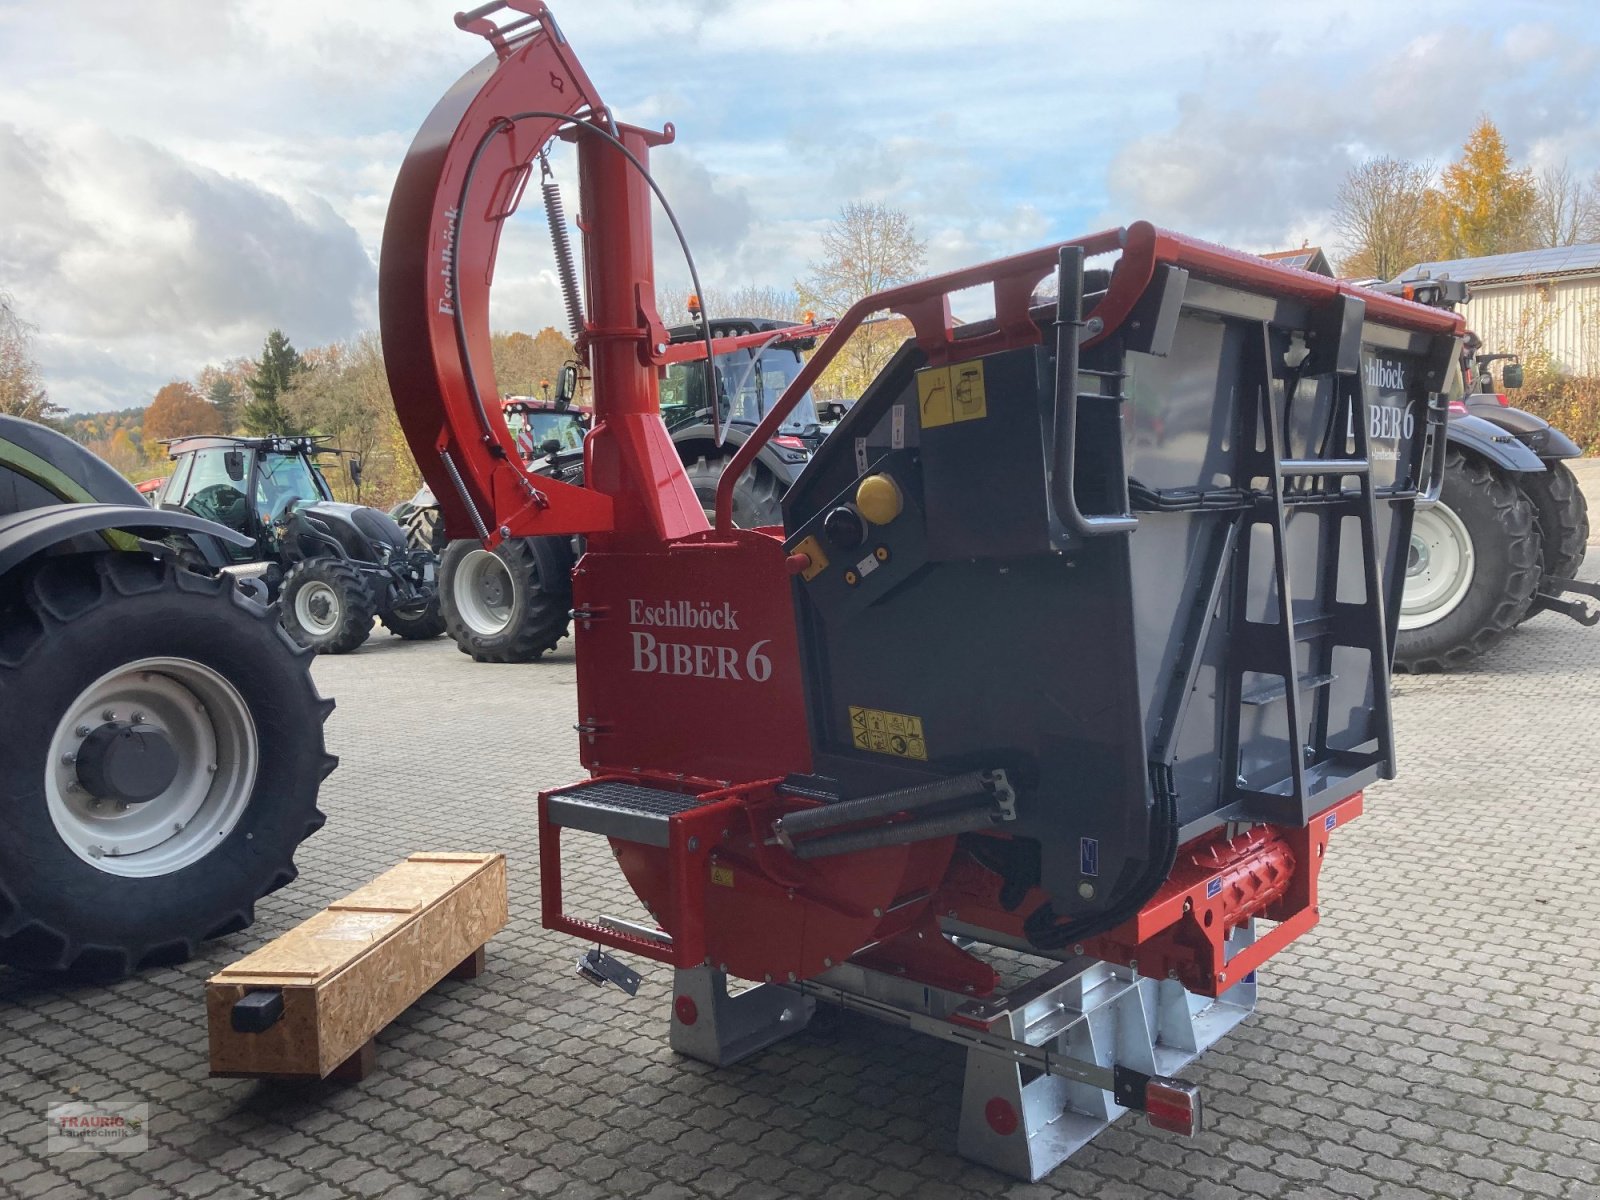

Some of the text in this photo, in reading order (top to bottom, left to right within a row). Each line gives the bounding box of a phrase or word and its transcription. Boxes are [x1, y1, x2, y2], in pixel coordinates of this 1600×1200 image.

[1402, 399, 1416, 440] 6
[628, 598, 740, 631] Eschlböck
[629, 631, 772, 682] BIBER 6
